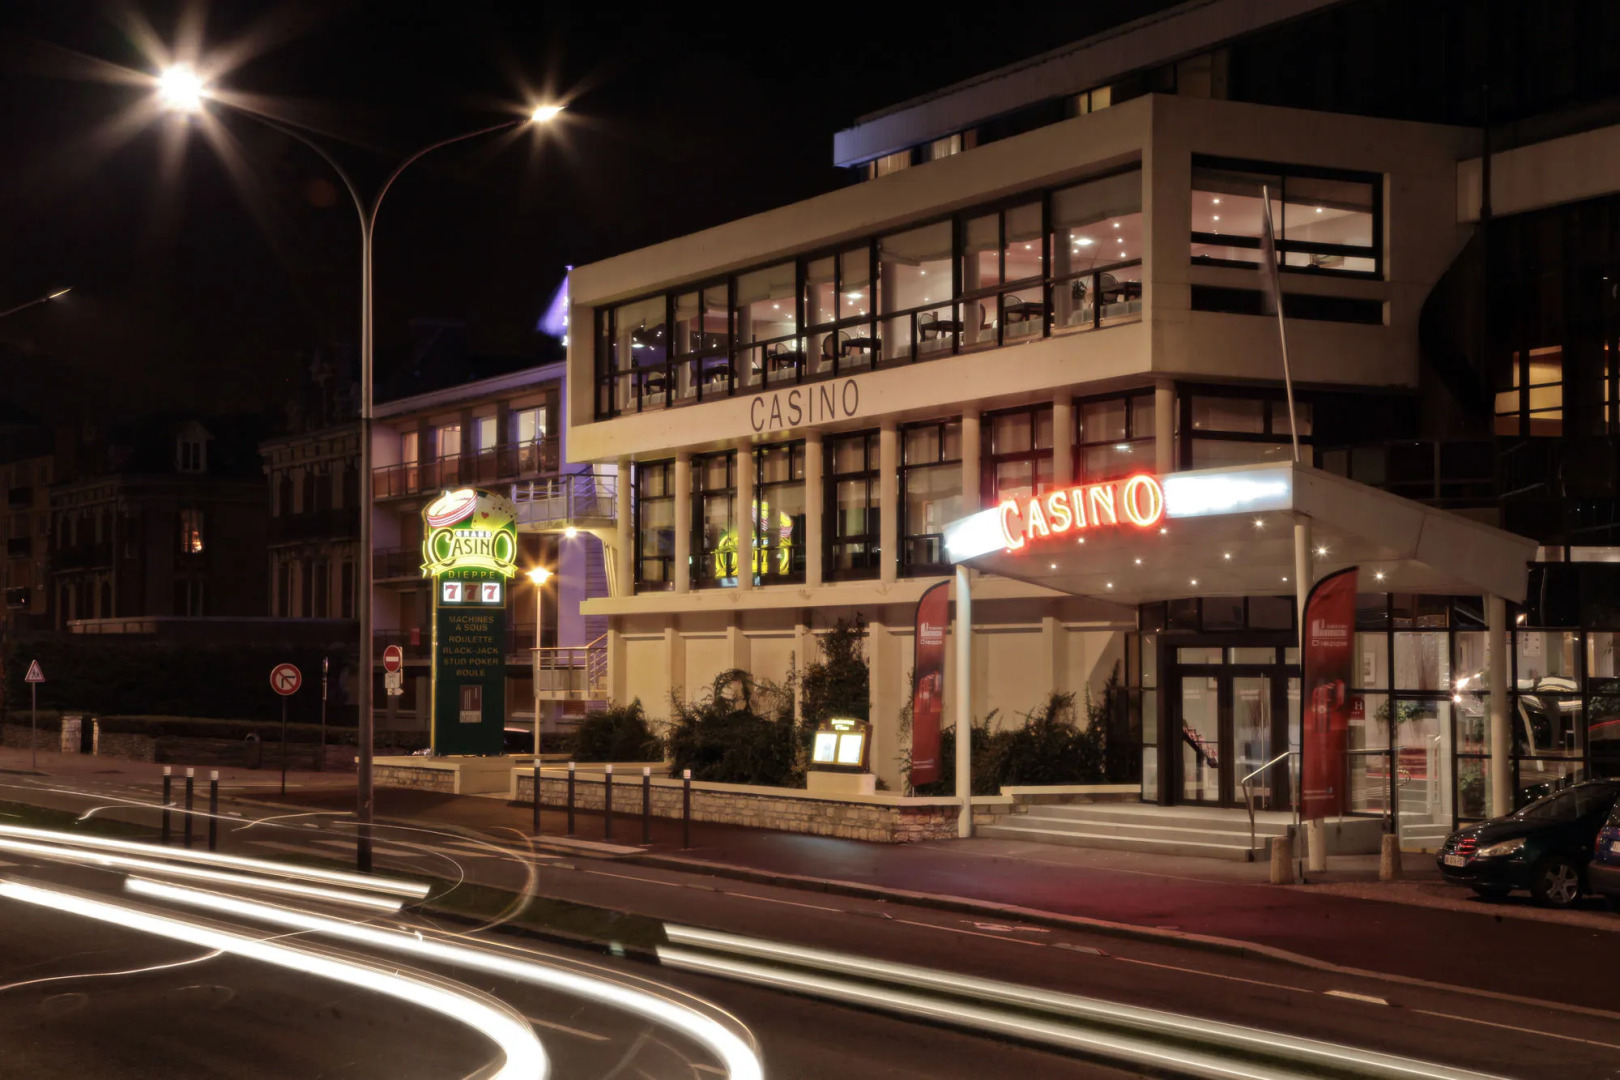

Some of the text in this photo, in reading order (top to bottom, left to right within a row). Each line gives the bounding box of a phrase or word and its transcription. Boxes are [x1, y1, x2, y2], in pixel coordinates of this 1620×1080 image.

[751, 379, 859, 432] CASINO
[999, 474, 1163, 550] CASINO
[428, 527, 516, 568] CASINO
[448, 570, 495, 578] DIEPPE
[445, 584, 498, 600] 7 7 7
[448, 615, 495, 624] MACHINES
[464, 623, 488, 632] SOUS
[448, 635, 494, 643] ROULETTE
[443, 657, 499, 666] STUD POKER
[456, 668, 485, 677] BOULE
